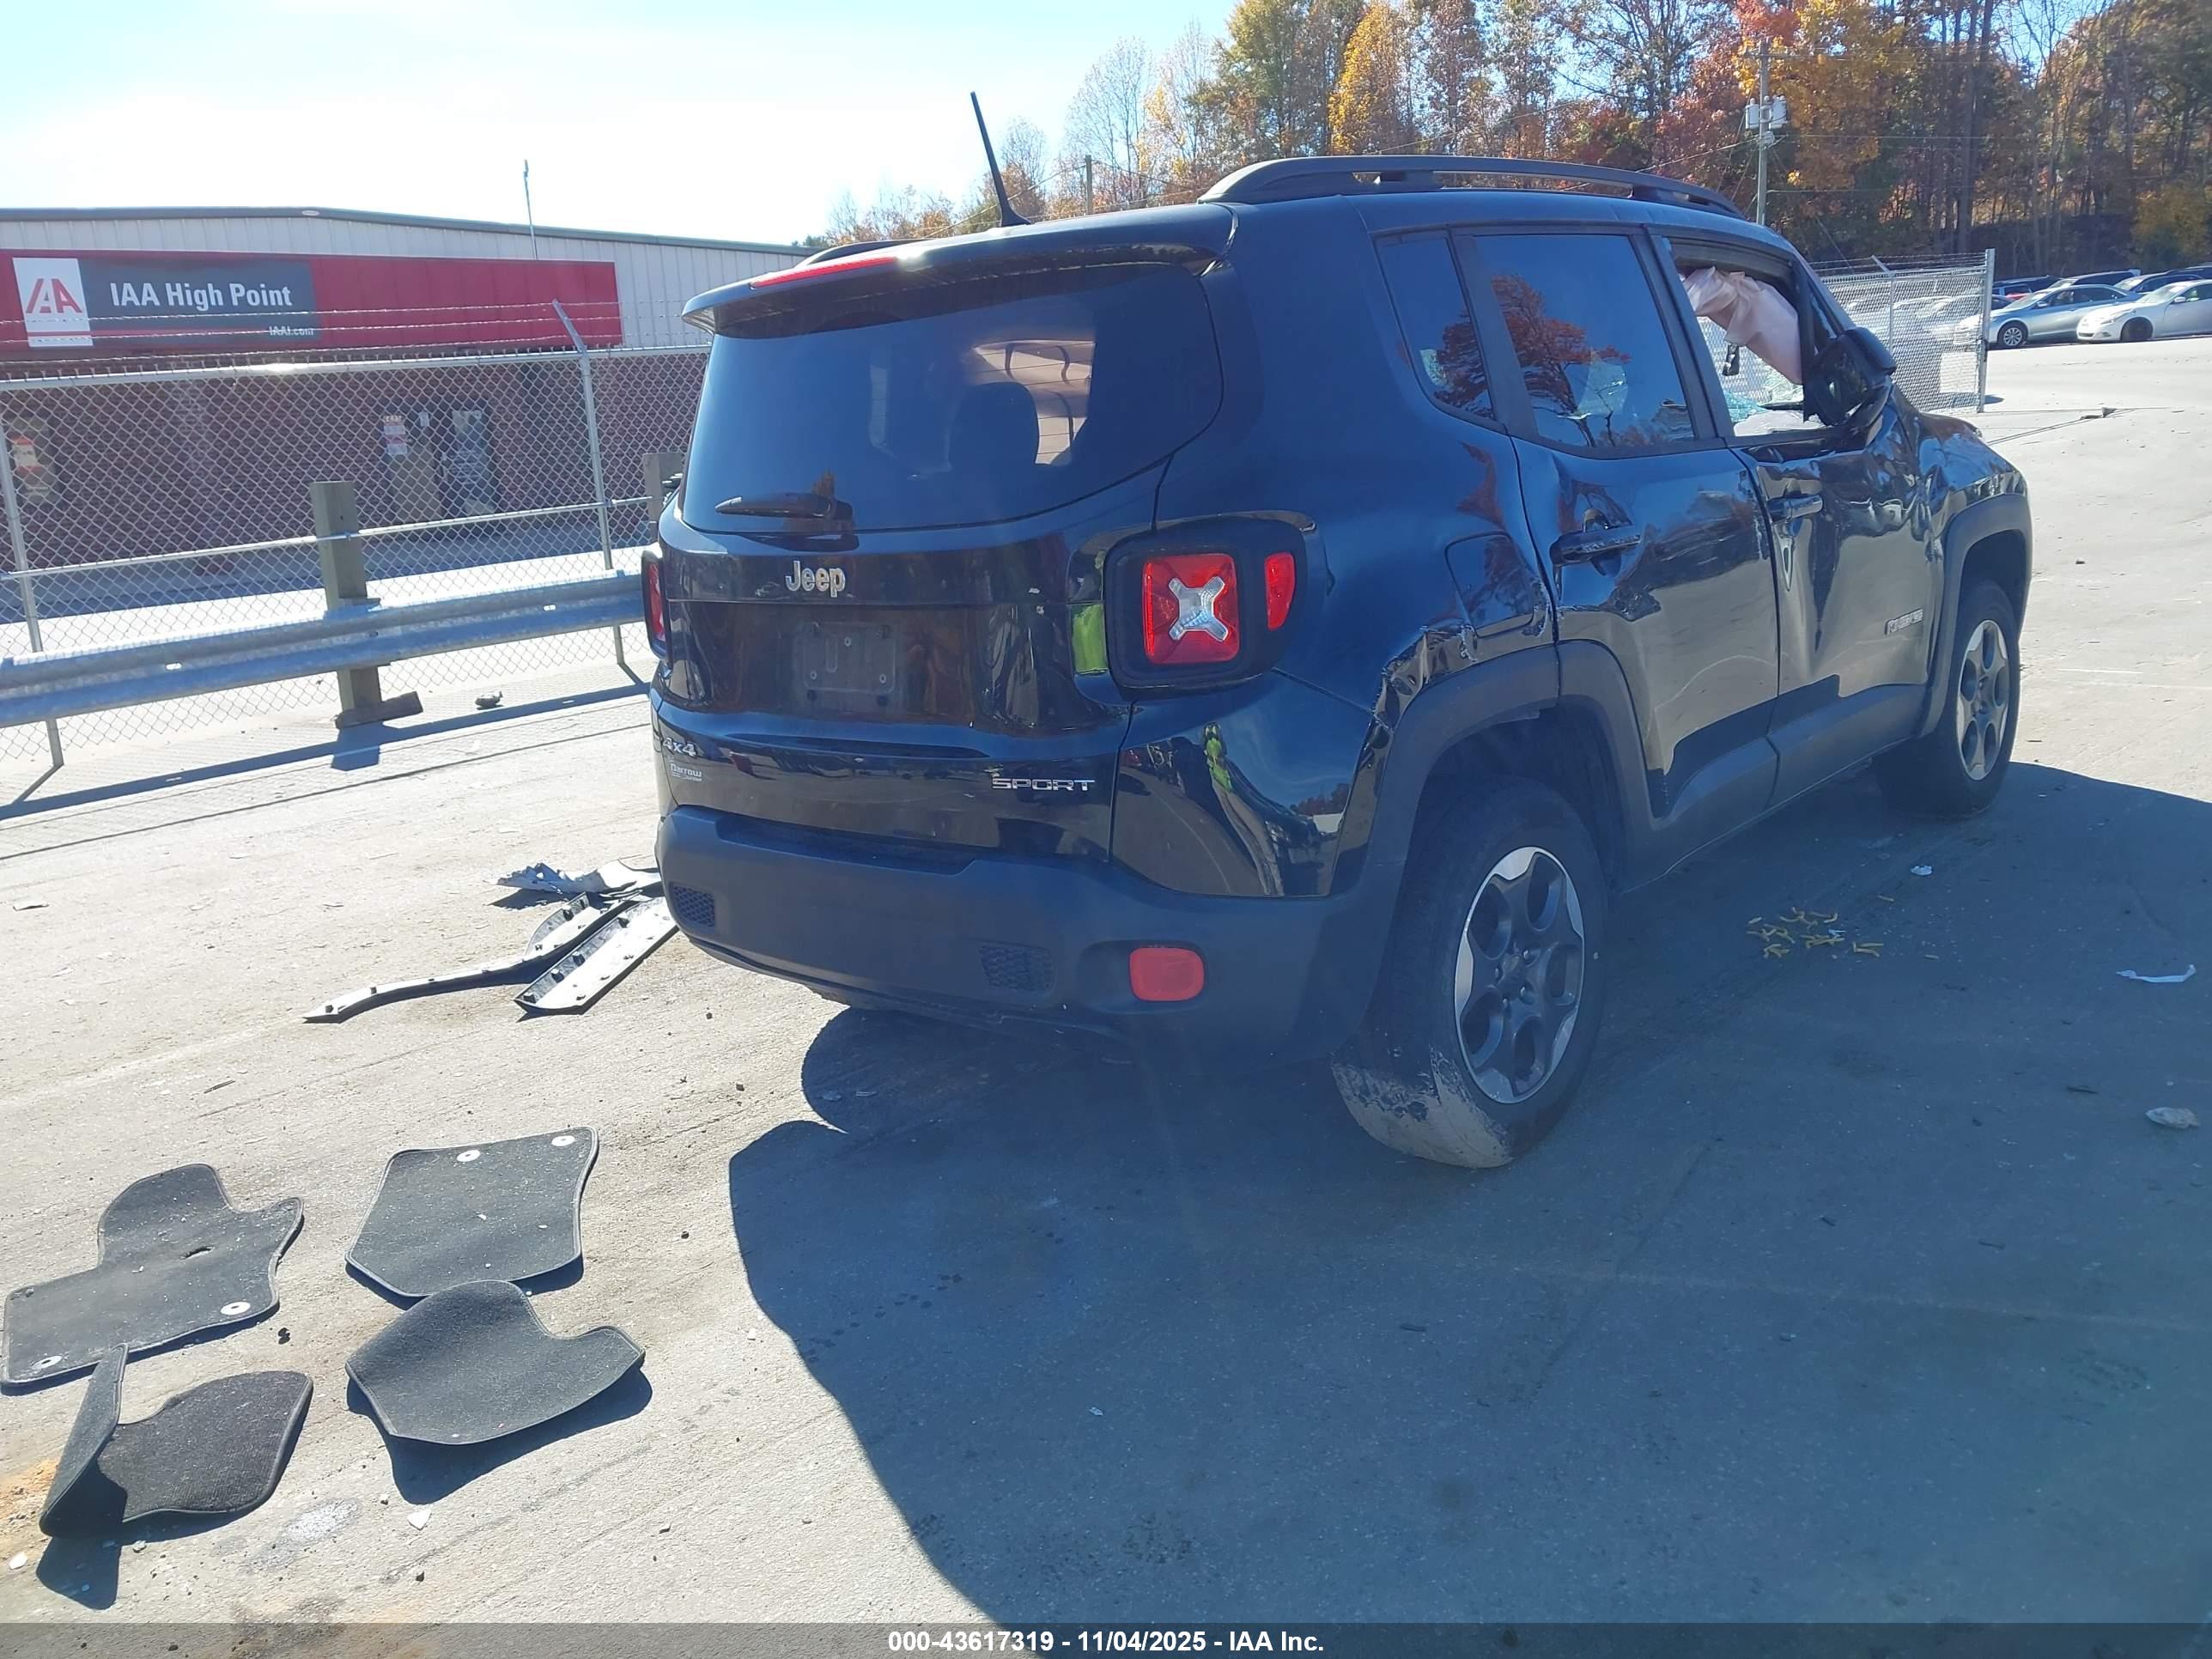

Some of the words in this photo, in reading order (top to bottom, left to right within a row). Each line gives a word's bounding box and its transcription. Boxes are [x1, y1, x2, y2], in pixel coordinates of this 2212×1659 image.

[110, 283, 161, 307] IAA
[166, 283, 223, 312] High
[229, 283, 293, 307] Point
[785, 560, 846, 598] Jeep
[662, 737, 696, 757] 4x4
[992, 778, 1095, 791] SPORT
